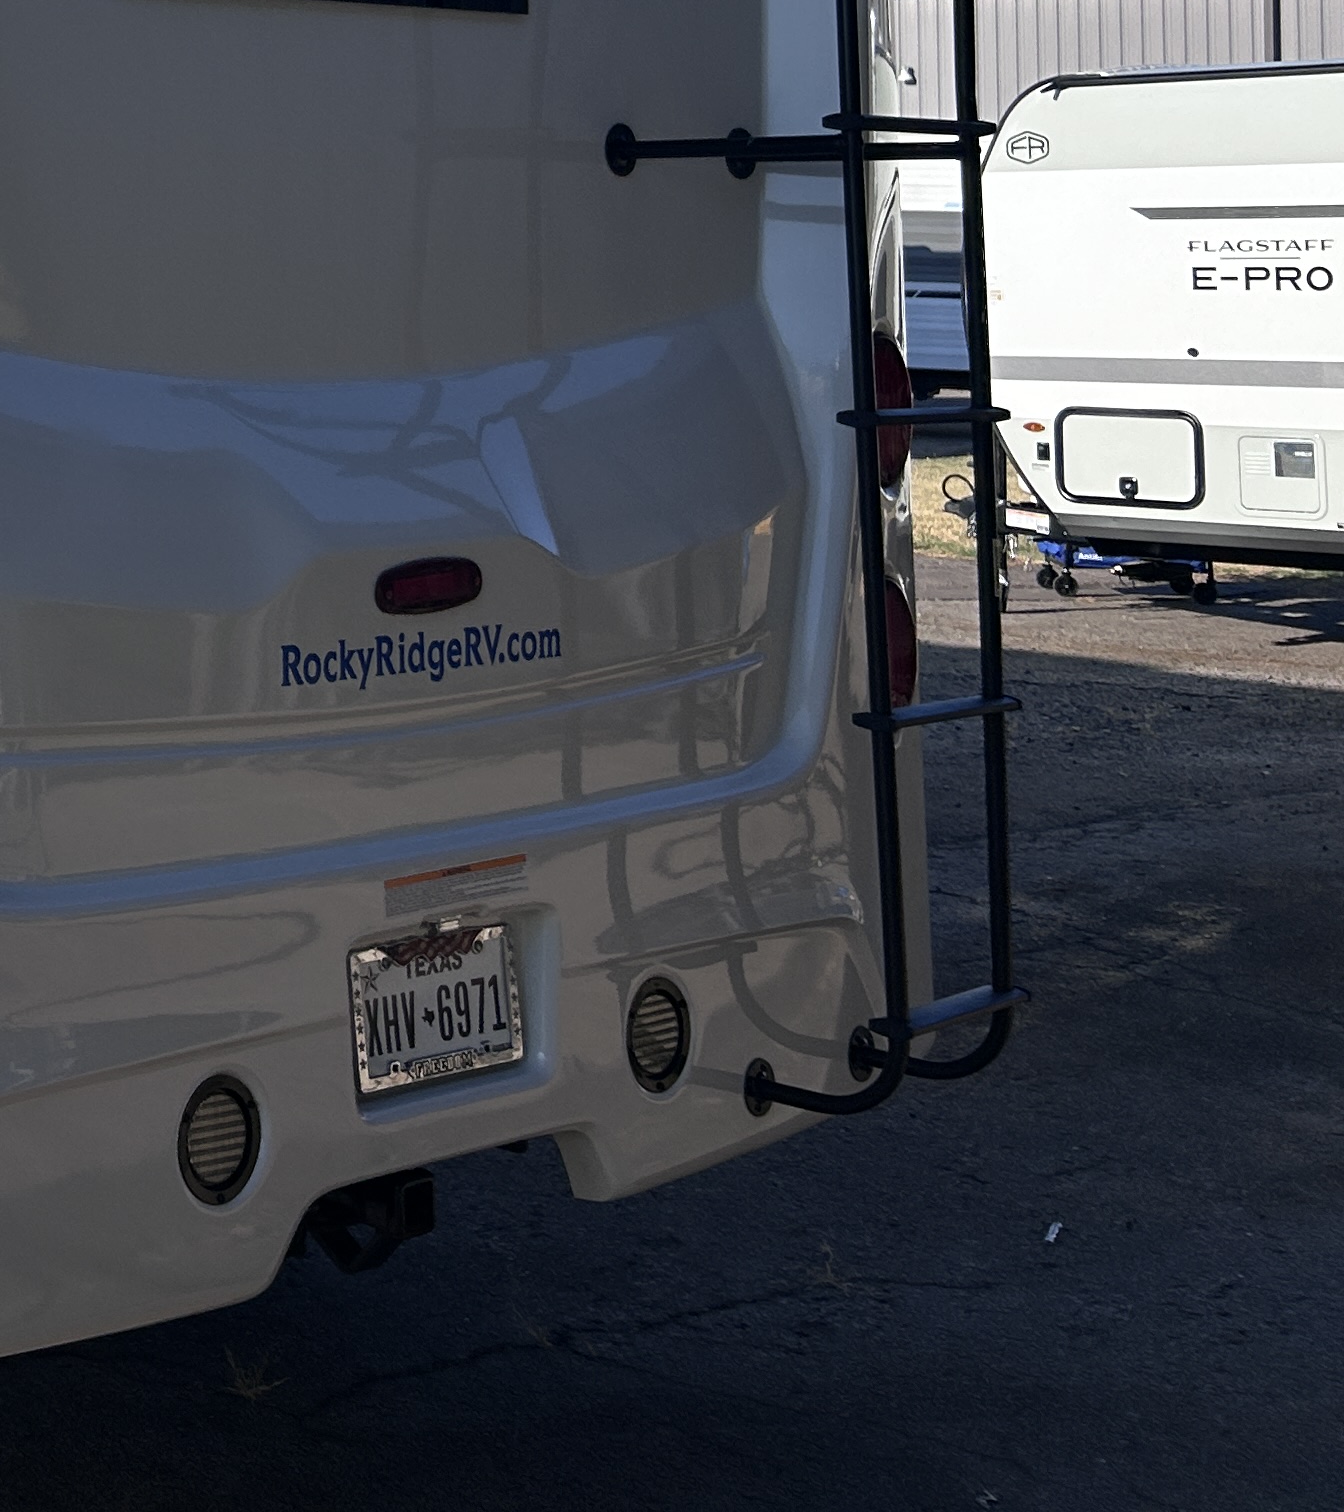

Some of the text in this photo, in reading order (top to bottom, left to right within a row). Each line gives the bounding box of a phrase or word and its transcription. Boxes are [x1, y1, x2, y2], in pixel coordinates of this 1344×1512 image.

[1187, 239, 1334, 252] FLAGSTAFF
[1192, 266, 1334, 291] E-PRO
[281, 624, 562, 690] RockyRidgeRV.com
